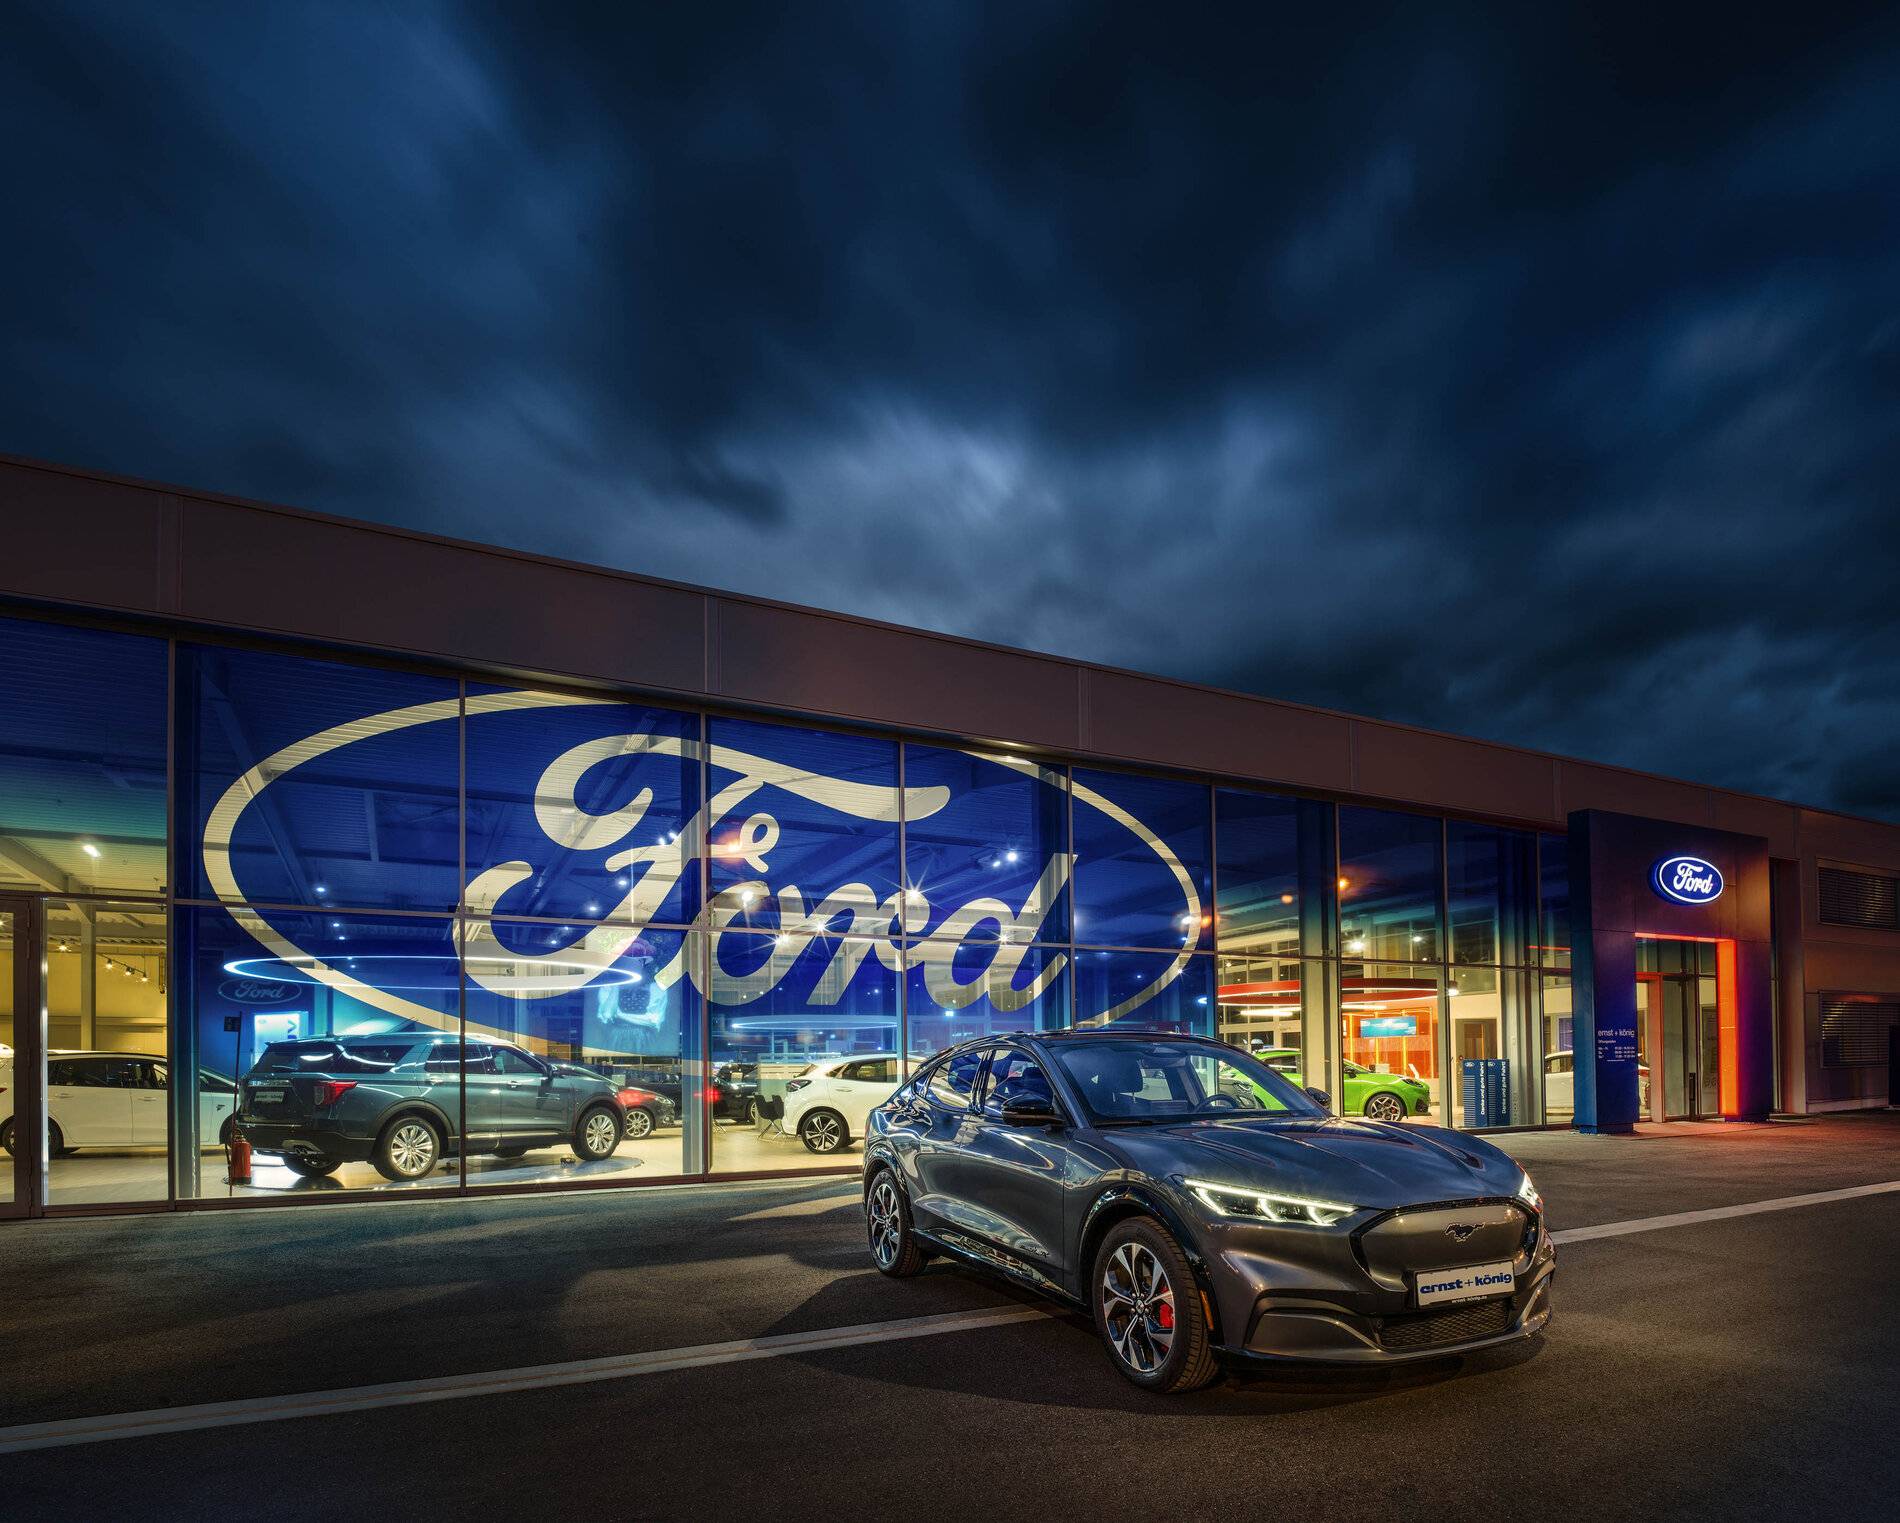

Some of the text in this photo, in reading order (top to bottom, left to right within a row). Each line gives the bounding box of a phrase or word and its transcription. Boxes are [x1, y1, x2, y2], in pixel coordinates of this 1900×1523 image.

[452, 734, 1077, 1012] Ford
[1673, 863, 1713, 893] Ford
[235, 980, 286, 998] Ford
[1619, 1029, 1635, 1038] könig
[1420, 1279, 1463, 1294] ernst
[1475, 1273, 1513, 1287] könig
